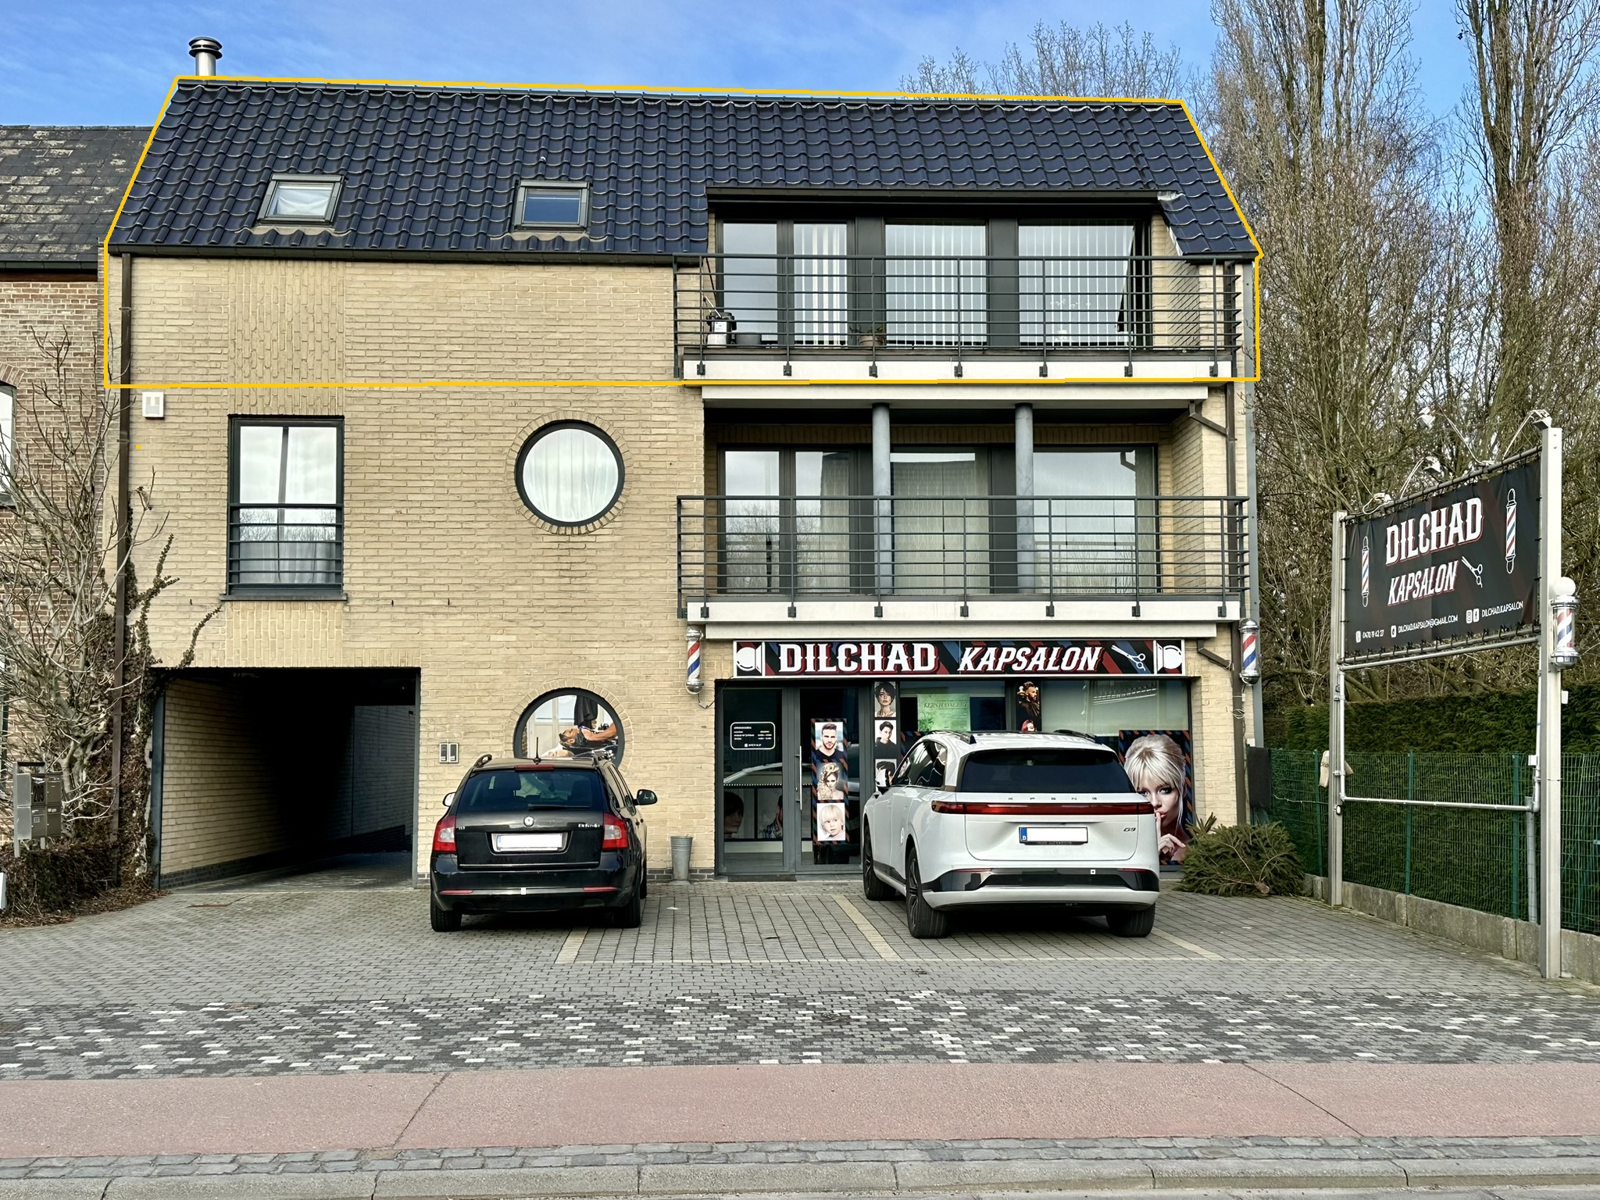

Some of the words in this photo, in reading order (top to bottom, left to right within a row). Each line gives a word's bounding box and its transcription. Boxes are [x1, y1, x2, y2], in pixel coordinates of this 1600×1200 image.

[1386, 497, 1484, 565] DILCHAD
[1388, 560, 1459, 605] KAPSALON
[778, 642, 938, 674] DILCHAD
[957, 645, 1104, 673] KAPSALON
